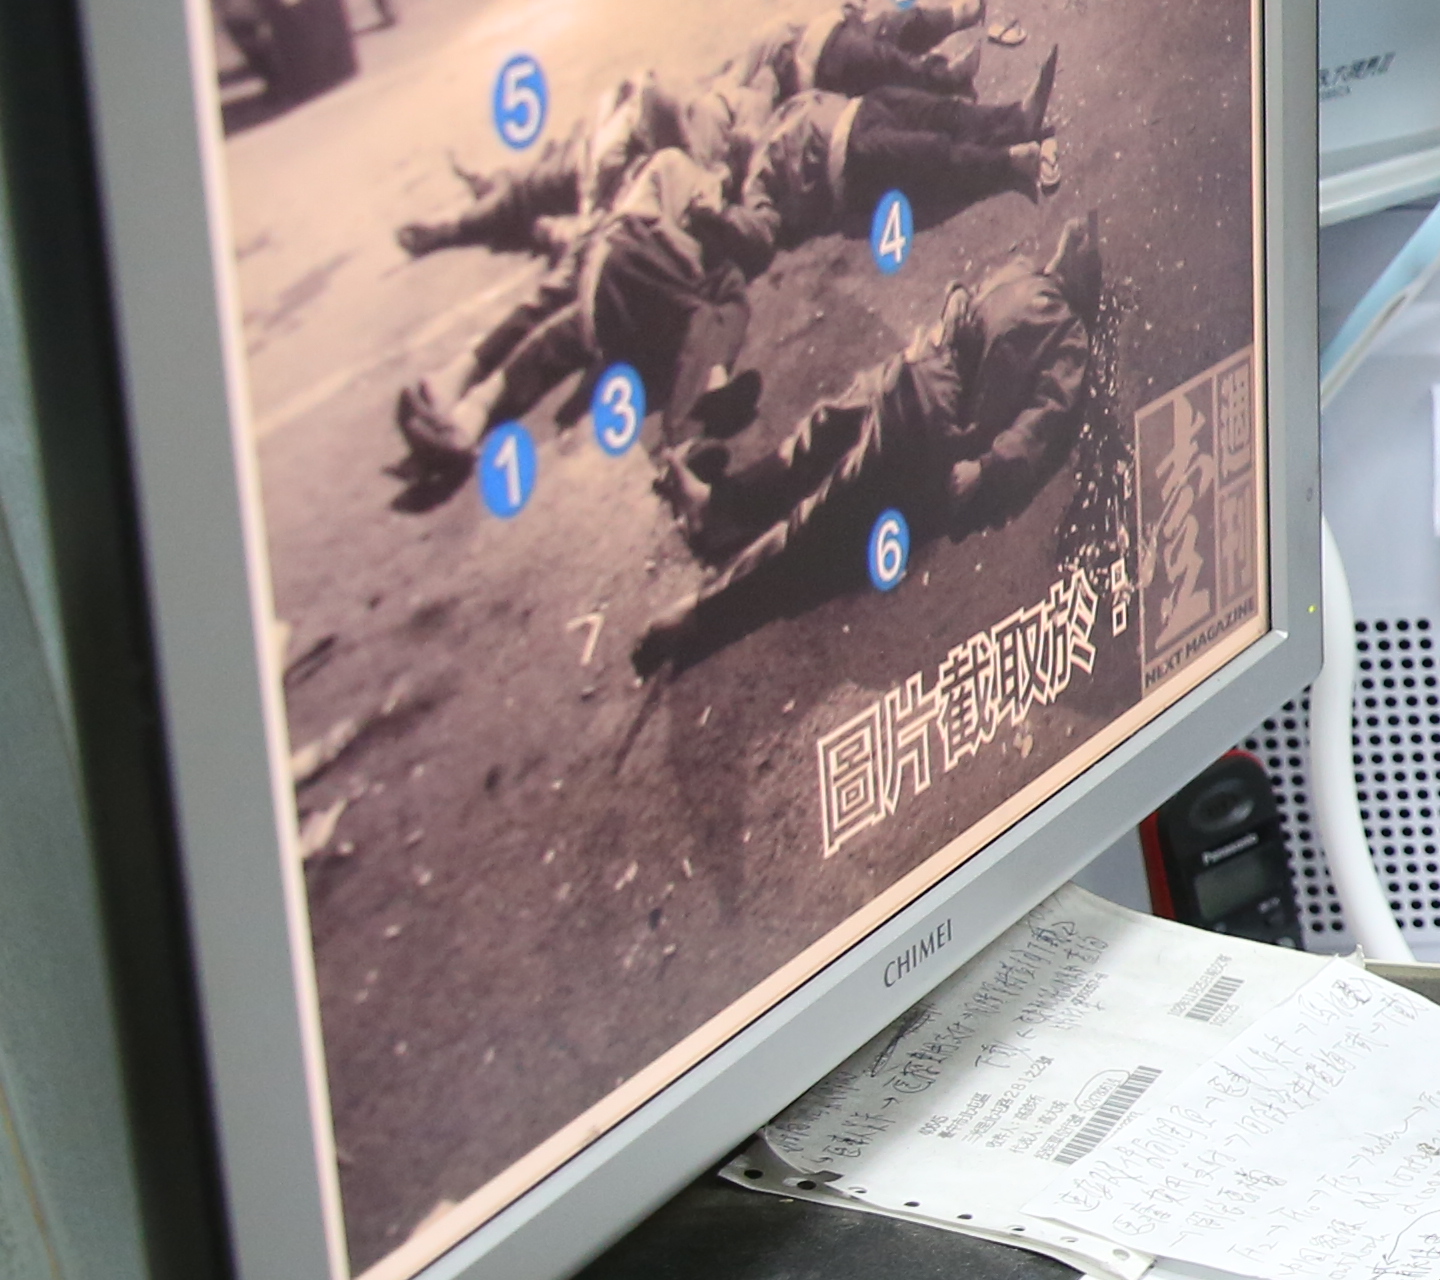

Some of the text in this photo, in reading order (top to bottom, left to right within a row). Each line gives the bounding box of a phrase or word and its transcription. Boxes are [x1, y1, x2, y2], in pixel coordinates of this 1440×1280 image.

[494, 66, 546, 142] 5
[873, 196, 909, 266] 4
[598, 371, 640, 446] 3
[488, 430, 530, 511] 1
[1219, 367, 1254, 605] 週刊
[872, 514, 906, 588] 6
[1145, 600, 1256, 690] NEXT MAGAZINE
[1201, 831, 1260, 868] Panasonic
[882, 918, 956, 989] CHIMEI
